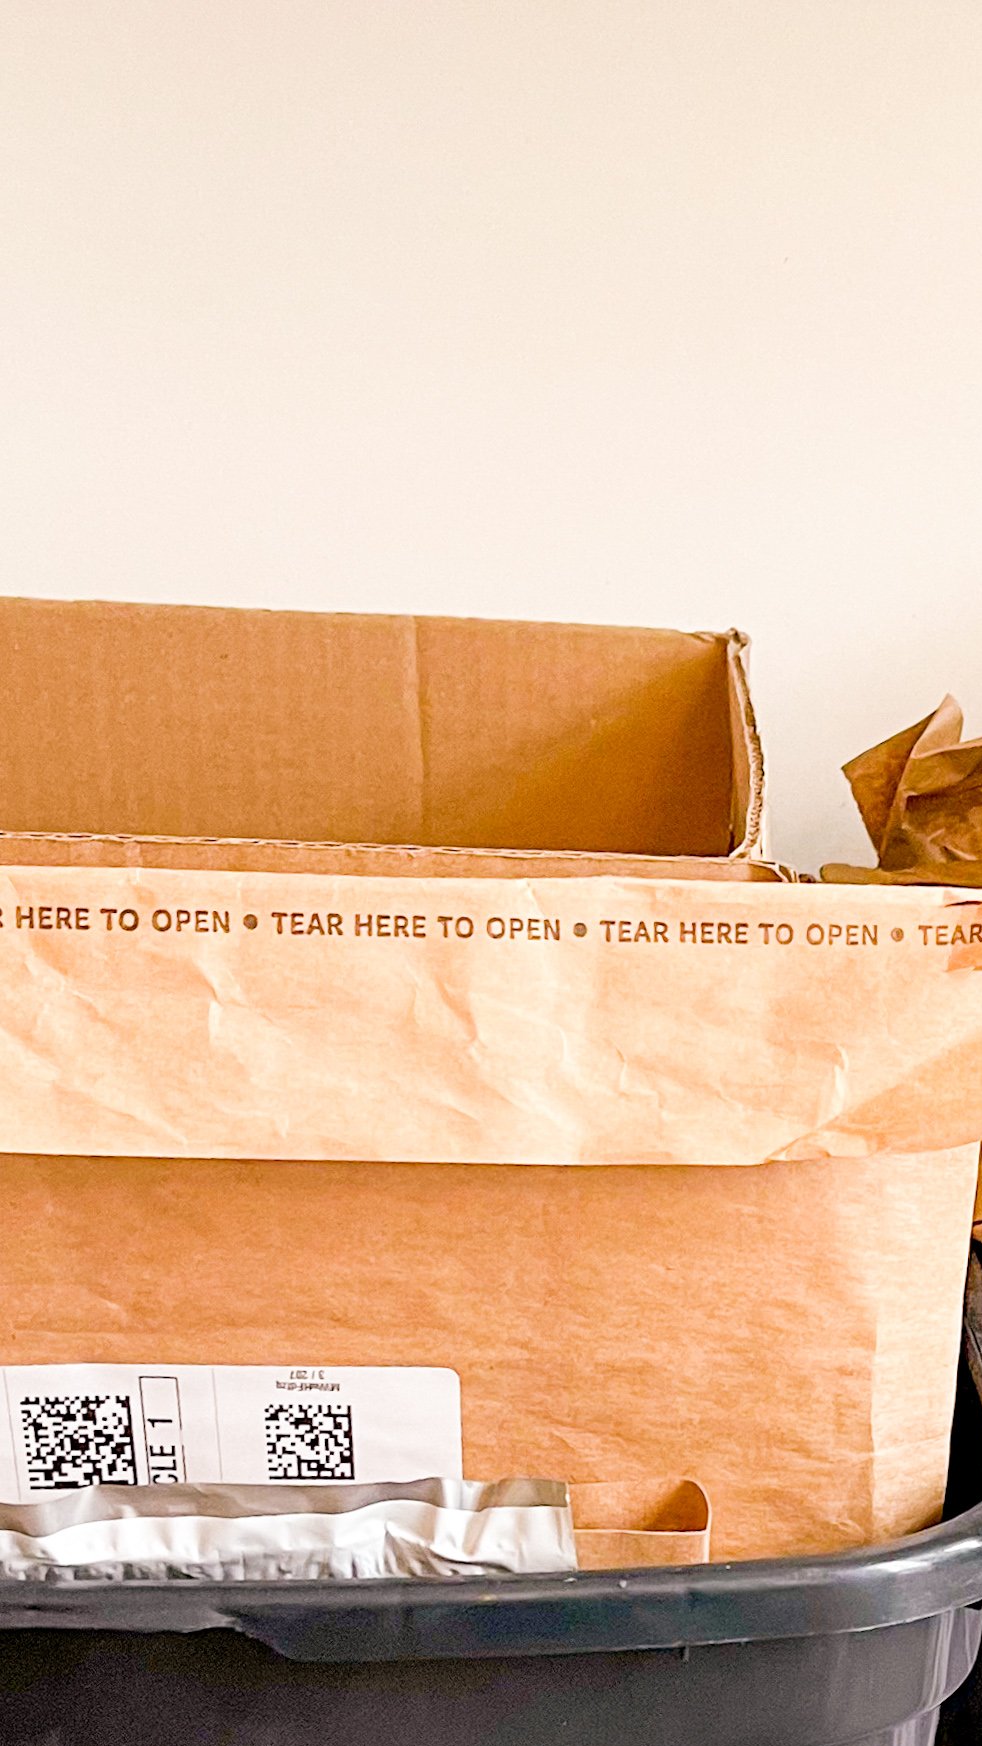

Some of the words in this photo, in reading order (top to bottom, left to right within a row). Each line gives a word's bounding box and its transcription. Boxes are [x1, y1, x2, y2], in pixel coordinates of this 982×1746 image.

[16, 905, 91, 931] HERE
[99, 908, 140, 932] TO
[151, 909, 230, 934] OPEN
[271, 911, 344, 936] TEAR
[354, 913, 427, 939] HERE
[437, 915, 474, 939] TO
[486, 916, 561, 941] OPEN
[599, 920, 669, 943] TEAR
[679, 921, 749, 945] HERE
[757, 922, 794, 945] TO
[806, 923, 878, 946] OPEN
[146, 1418, 173, 1428] 1
